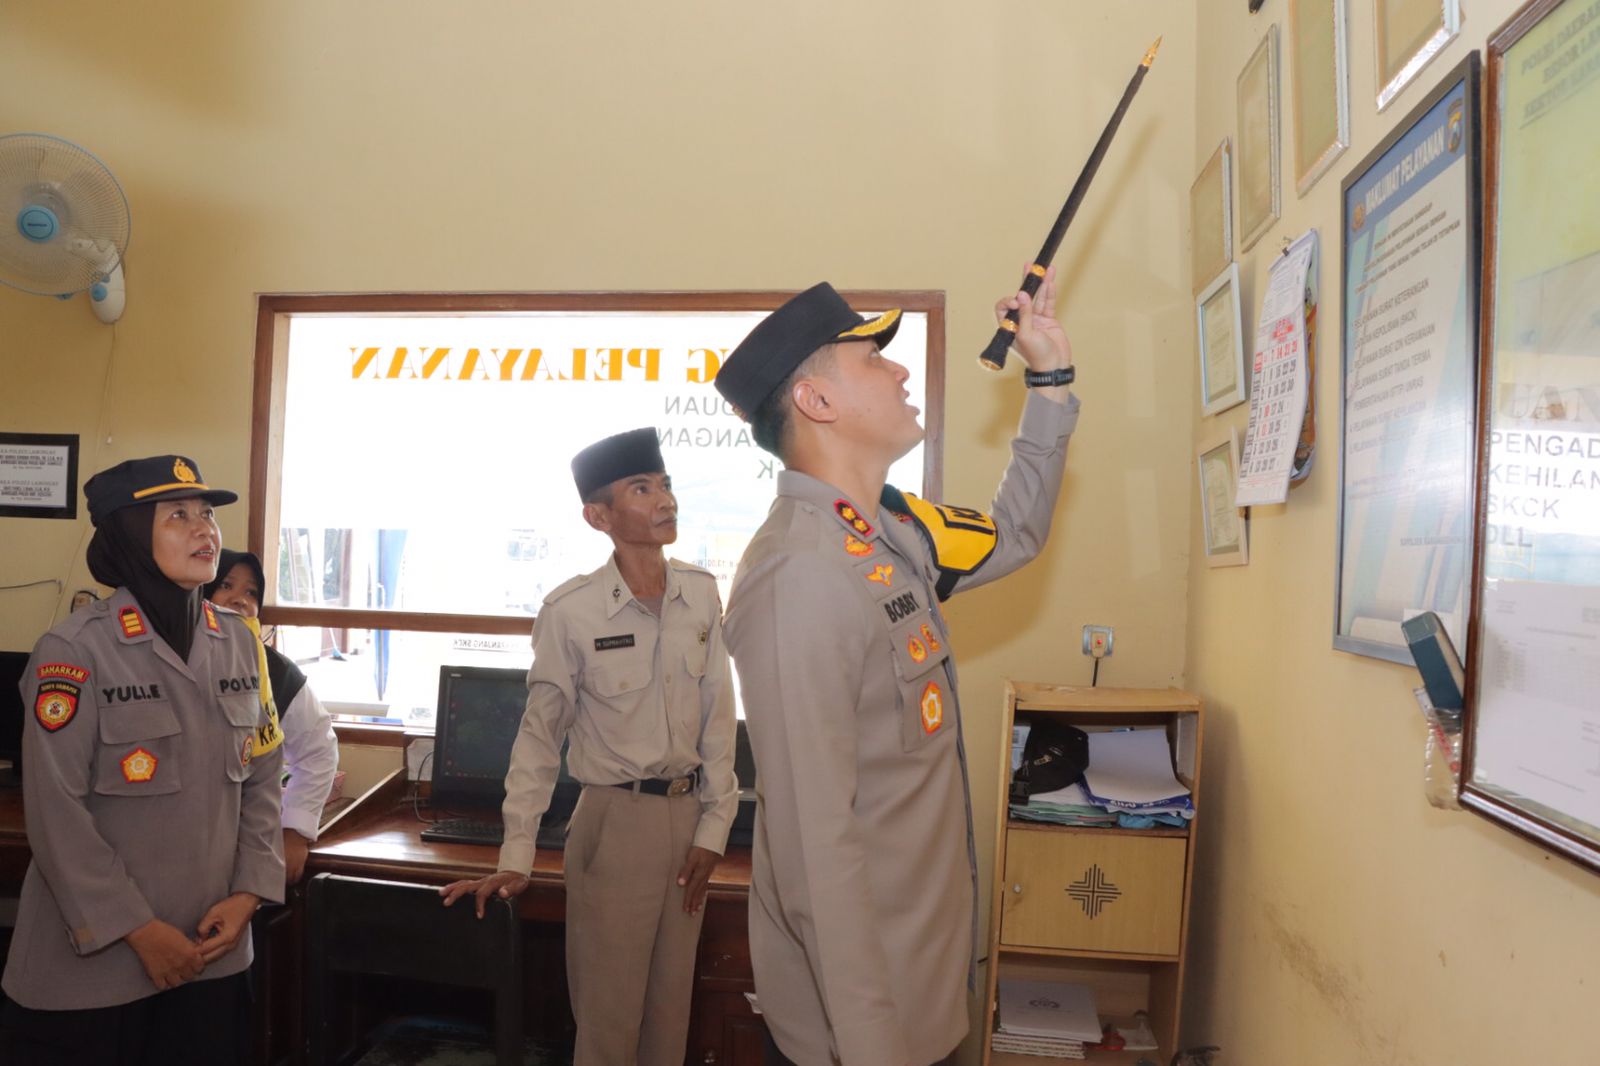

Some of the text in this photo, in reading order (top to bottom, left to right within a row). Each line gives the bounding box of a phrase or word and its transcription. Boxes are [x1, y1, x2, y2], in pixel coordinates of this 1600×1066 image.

[1400, 125, 1444, 187] PELAYANAN
[884, 591, 920, 624] BOBBY
[219, 676, 260, 693] POLR
